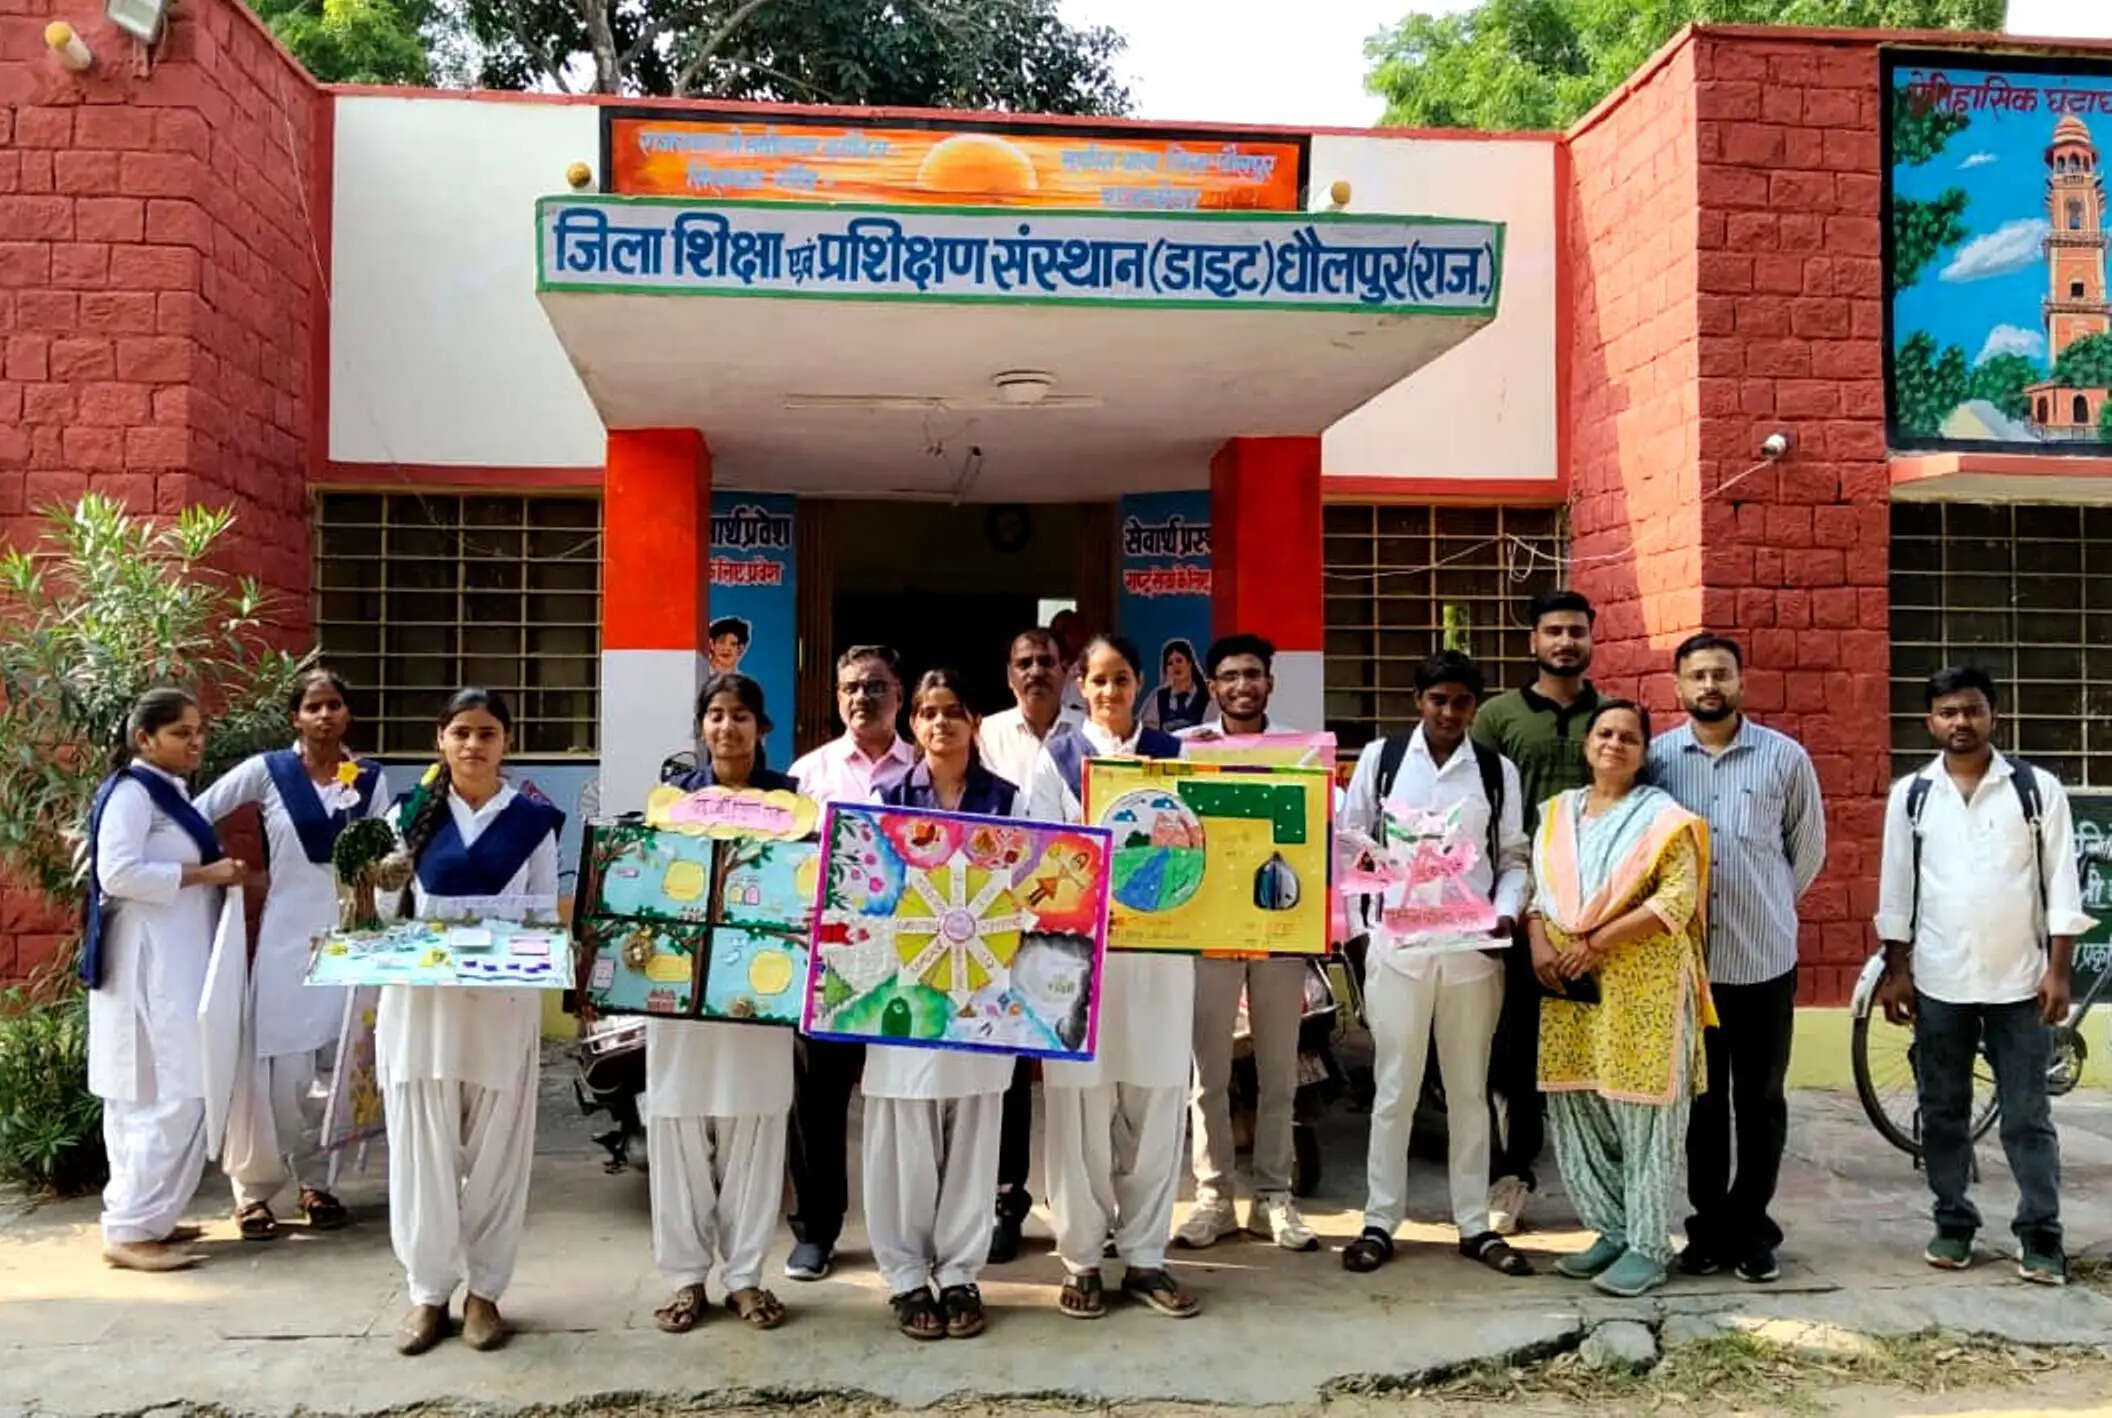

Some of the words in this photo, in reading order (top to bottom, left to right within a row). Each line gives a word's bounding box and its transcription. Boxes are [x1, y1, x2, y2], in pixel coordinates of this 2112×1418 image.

[2043, 76, 2112, 114] घंटाघ
[553, 206, 666, 275] जिला
[672, 211, 785, 285] शिक्षा
[785, 236, 817, 284] एवं
[817, 216, 990, 291] प्रशिक्षण
[991, 223, 1149, 291] संस्थान
[1150, 237, 1275, 298] (डाइट)
[1276, 226, 1408, 304] धौलपुर
[1407, 239, 1495, 304] (राज.)
